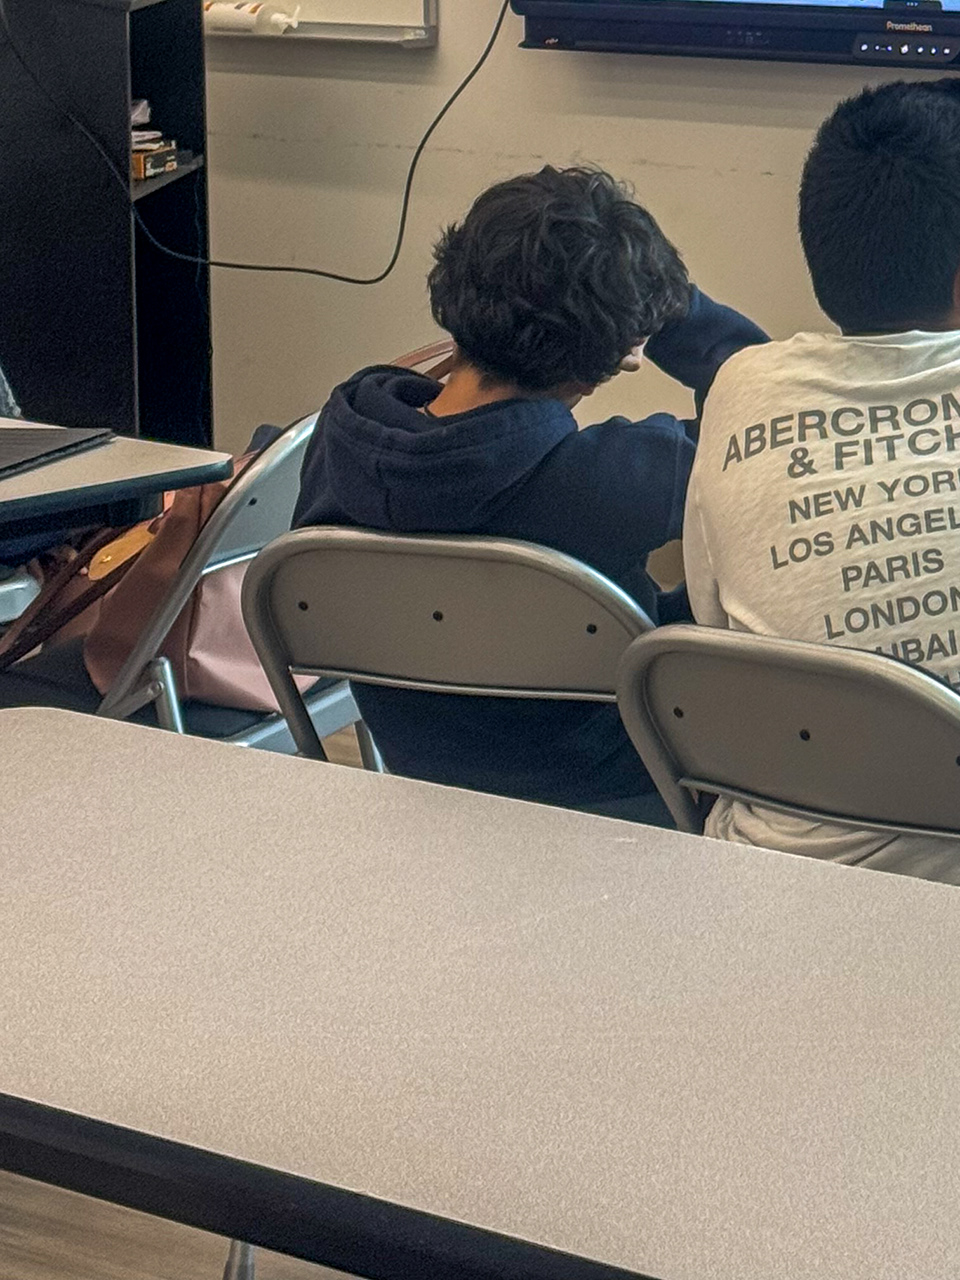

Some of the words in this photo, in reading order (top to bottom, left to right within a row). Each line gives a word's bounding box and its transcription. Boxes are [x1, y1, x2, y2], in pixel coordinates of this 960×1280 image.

[886, 21, 933, 32] Promethean
[786, 448, 818, 479] &
[788, 484, 867, 524] NEW
[770, 530, 836, 570] LOS
[841, 548, 945, 592] PARIS
